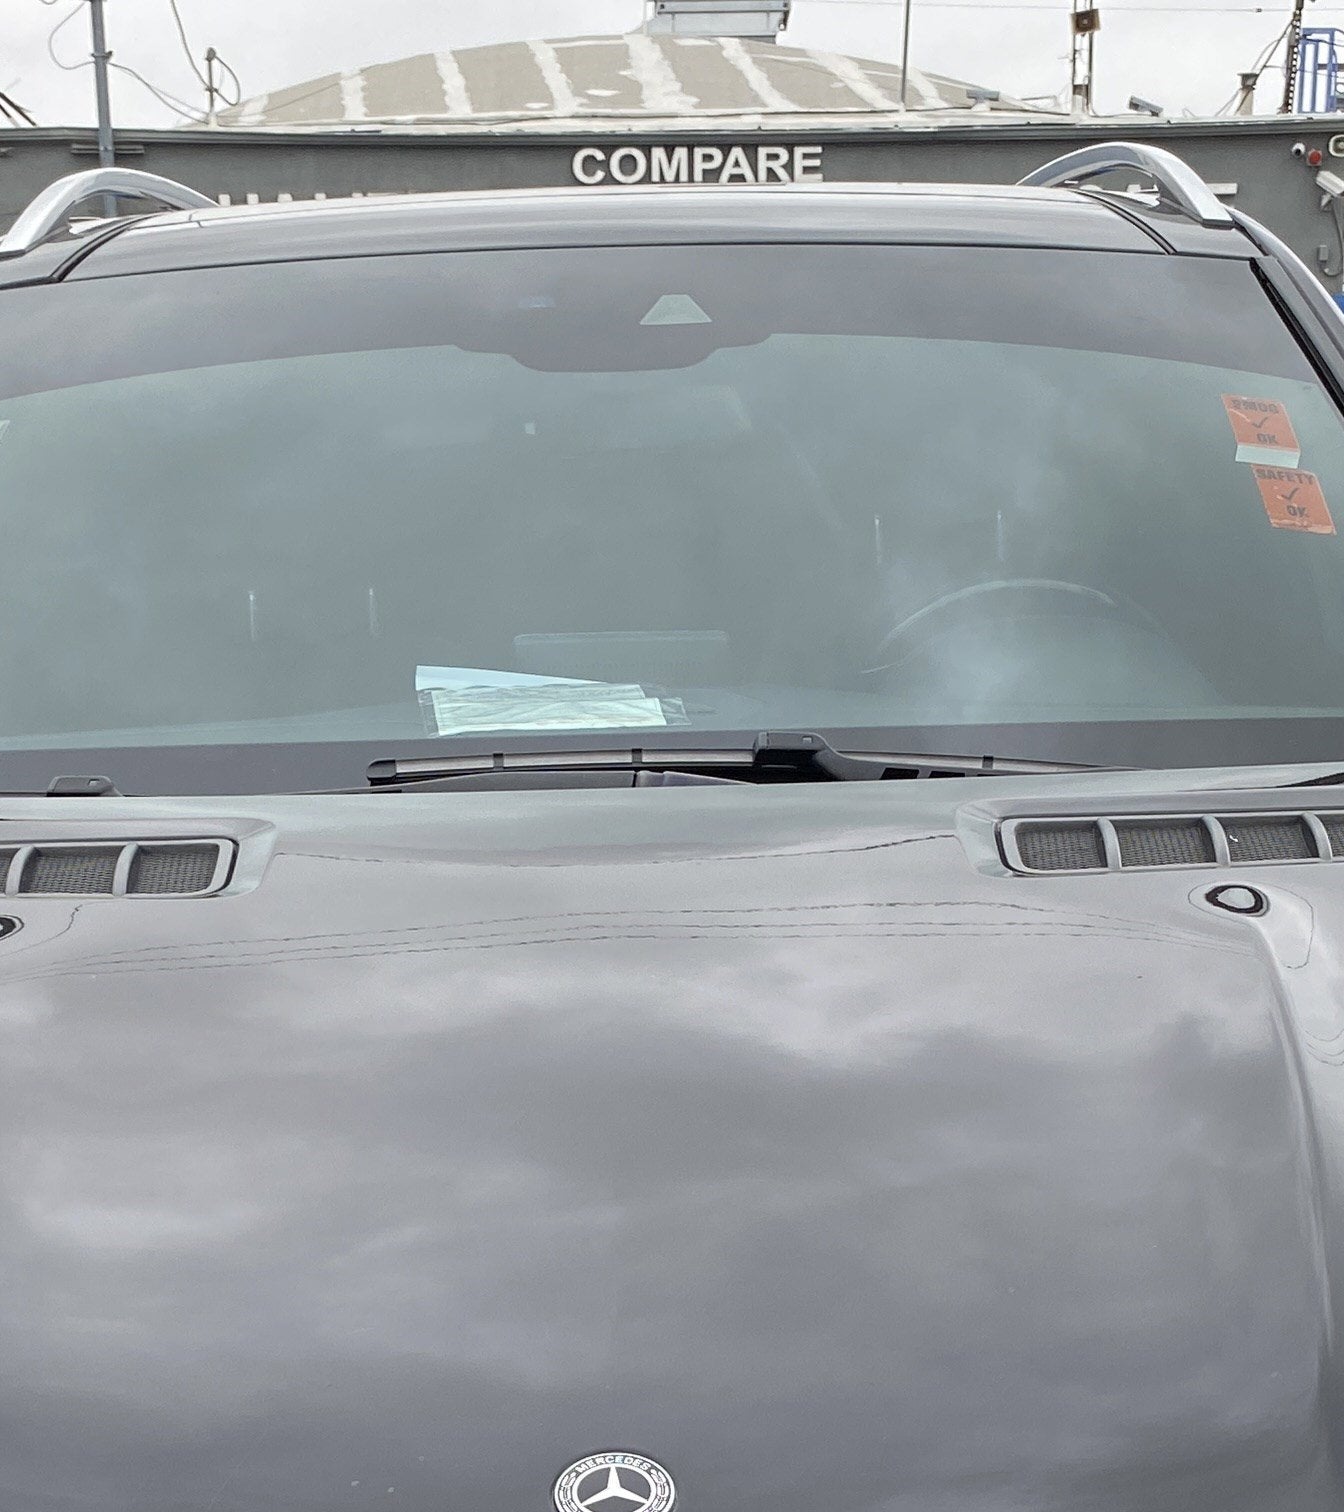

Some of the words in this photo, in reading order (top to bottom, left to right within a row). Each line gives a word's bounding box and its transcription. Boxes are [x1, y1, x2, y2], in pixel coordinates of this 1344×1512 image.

[571, 145, 825, 185] COMPARE
[1256, 468, 1314, 485] SAFETY
[575, 1456, 652, 1473] MERCEDES
